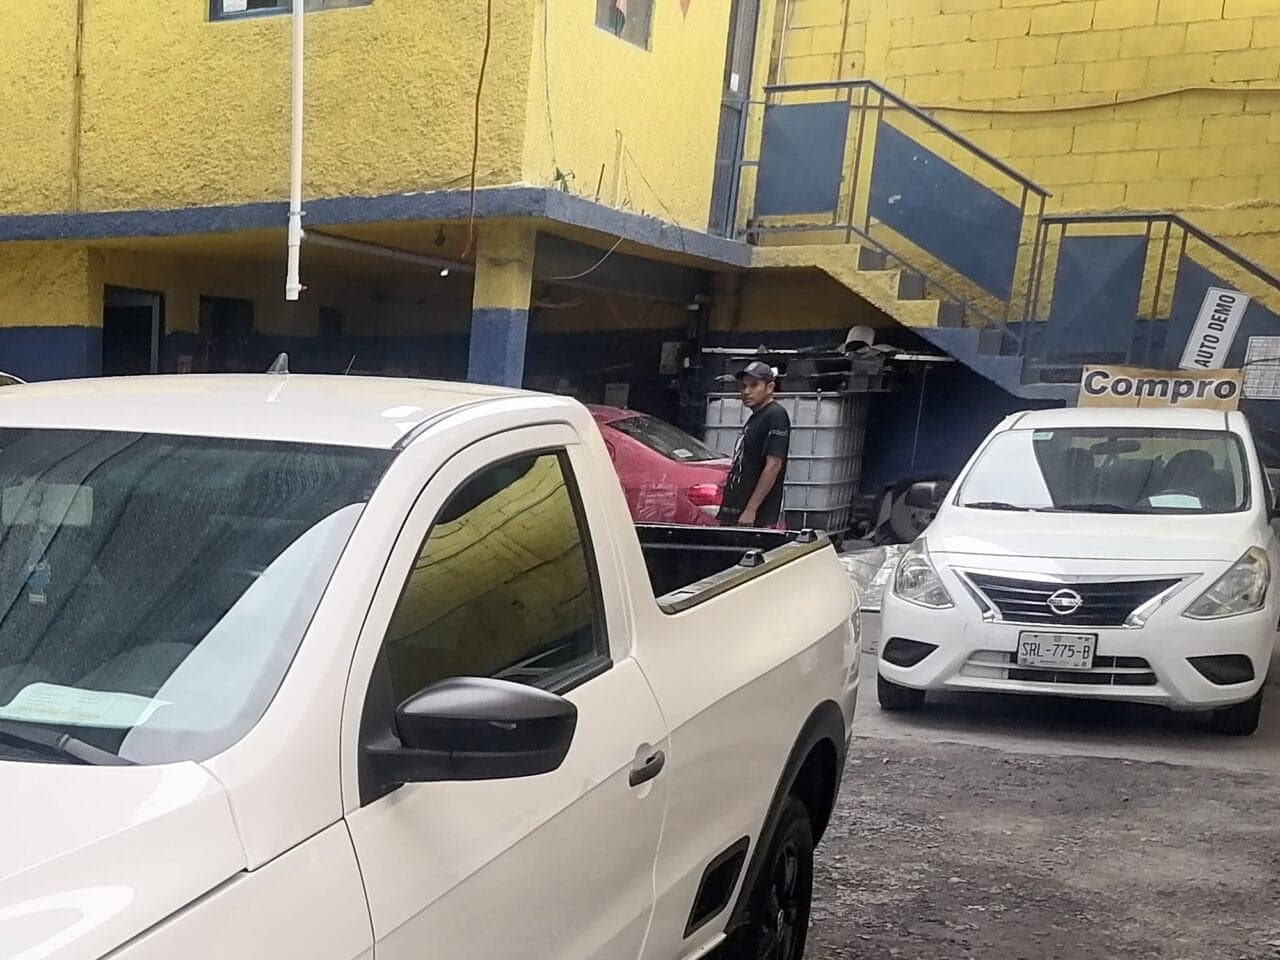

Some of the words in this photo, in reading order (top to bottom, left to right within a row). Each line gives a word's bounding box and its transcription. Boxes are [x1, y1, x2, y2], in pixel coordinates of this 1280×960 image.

[1194, 334, 1220, 368] AUTO
[1213, 294, 1236, 333] DEMO
[1084, 370, 1238, 405] Compro
[1021, 642, 1091, 660] SRL-775-B
